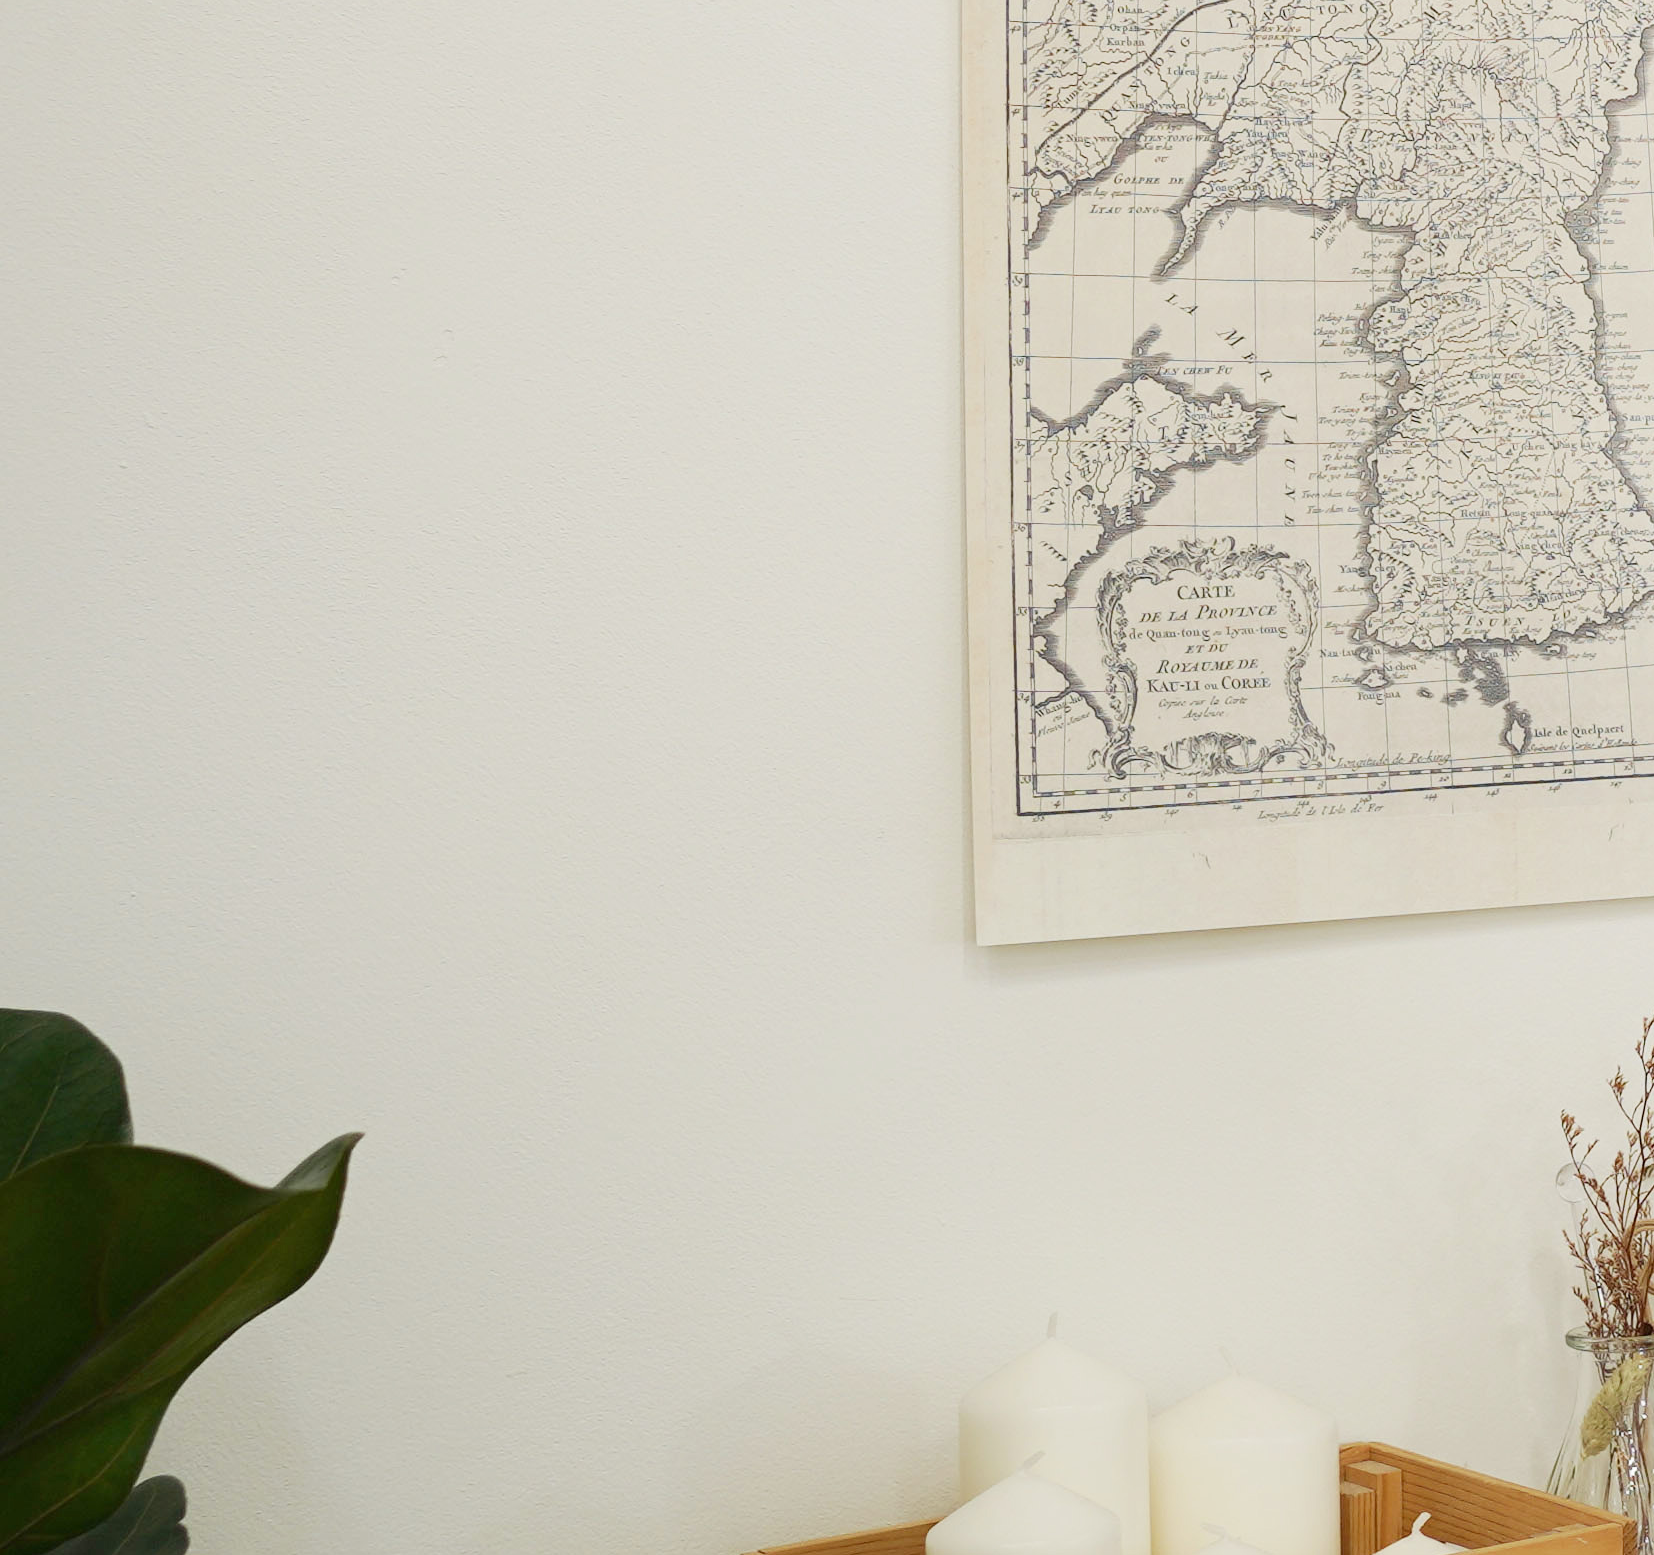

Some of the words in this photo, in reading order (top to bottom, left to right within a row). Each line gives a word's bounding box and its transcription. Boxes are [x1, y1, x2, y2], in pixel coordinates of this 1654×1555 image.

[1113, 174, 1160, 186] GOLPHE
[1168, 177, 1184, 185] DE
[1177, 585, 1236, 600] CARTE
[1139, 611, 1162, 623] DE
[1167, 609, 1188, 622] LA
[1195, 604, 1277, 620] PROVINCE
[1129, 627, 1143, 640] de
[1185, 644, 1204, 654] ET
[1208, 643, 1228, 654] DU
[1156, 658, 1238, 675] ROYAUME
[1238, 658, 1259, 670] DE
[1146, 678, 1200, 693] KAU-LI
[1204, 683, 1217, 691] ou
[1221, 670, 1271, 690] CORÉE
[1534, 727, 1552, 738] Isle
[1555, 725, 1569, 736] de
[1393, 753, 1405, 765] de
